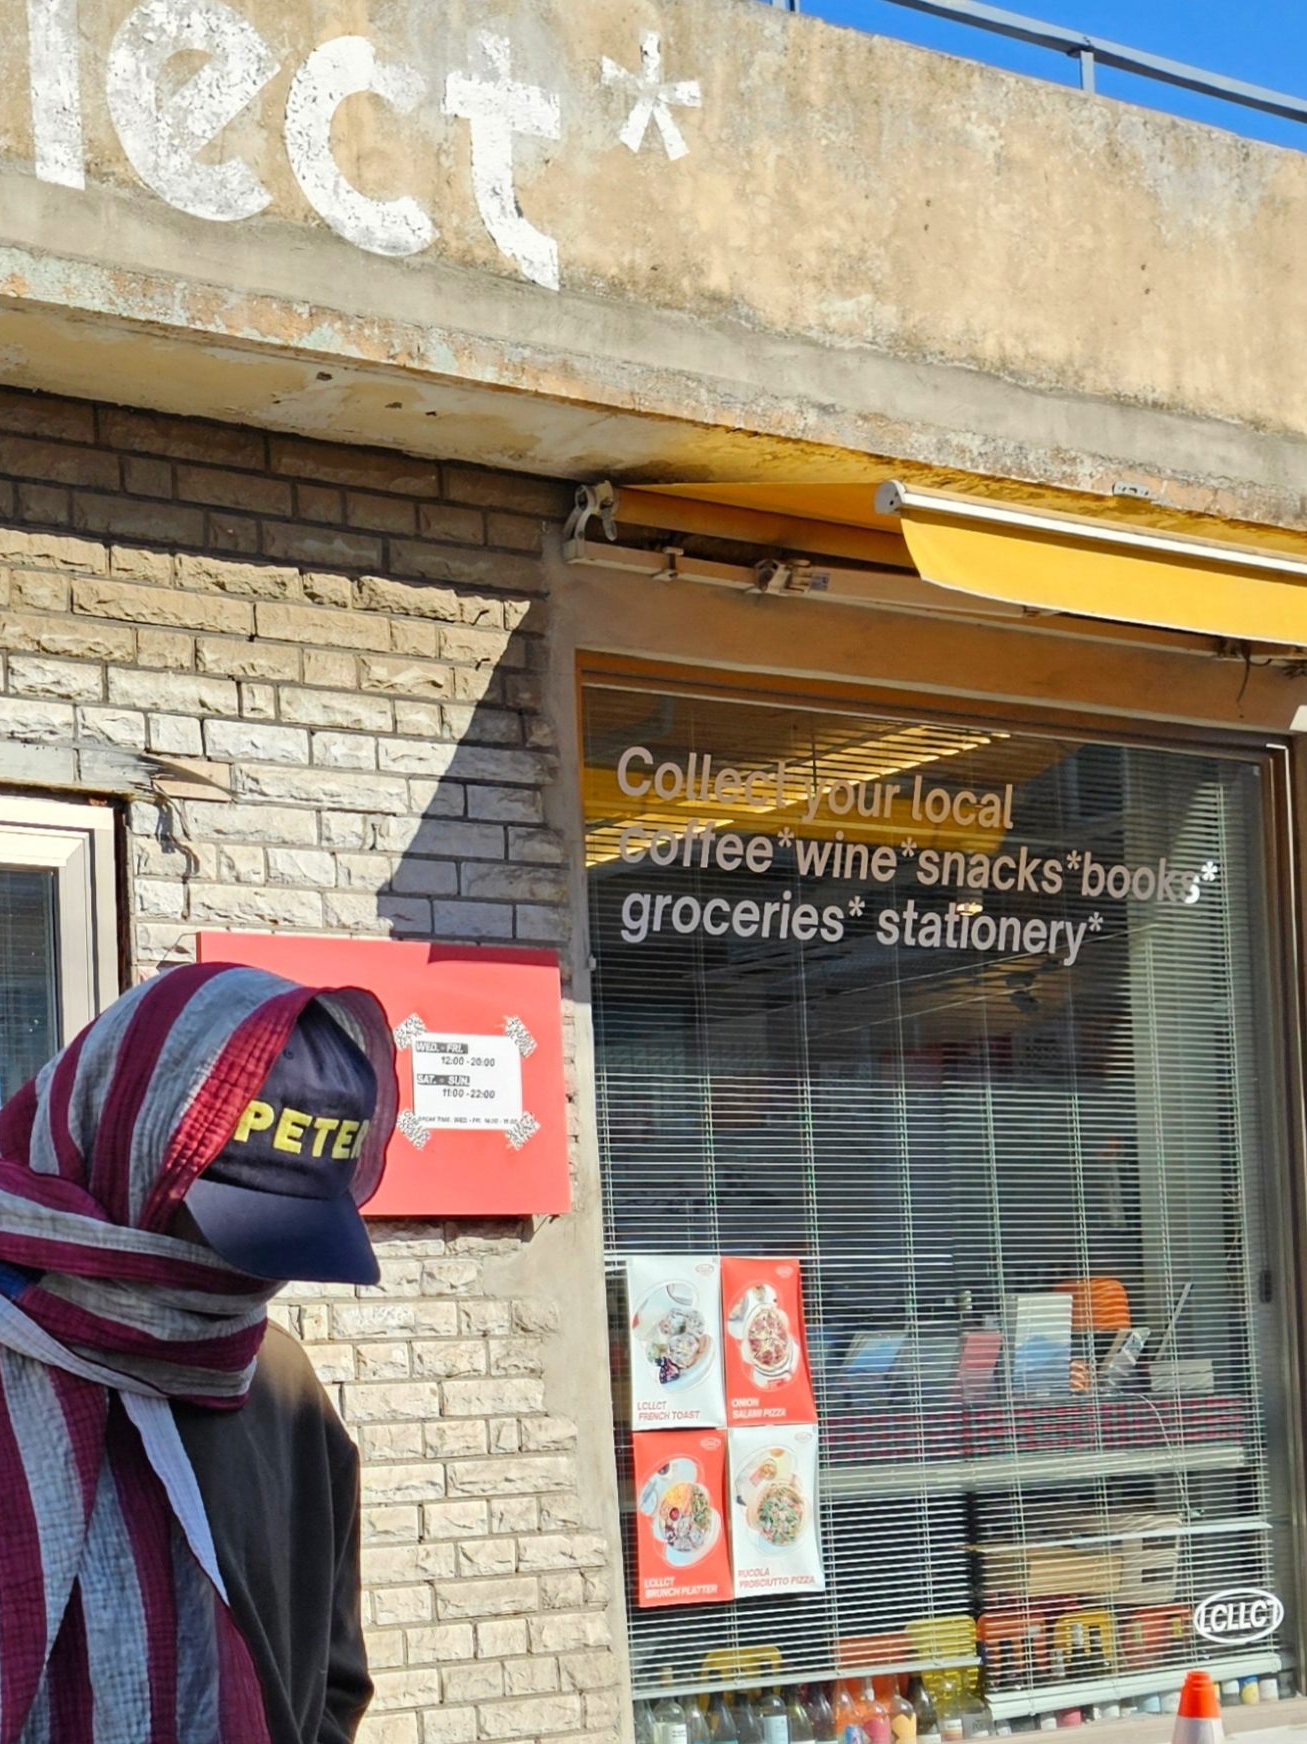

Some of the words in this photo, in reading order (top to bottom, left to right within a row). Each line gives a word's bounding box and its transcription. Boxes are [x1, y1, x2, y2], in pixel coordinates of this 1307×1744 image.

[617, 746, 787, 809] Collect
[801, 777, 901, 823] your
[911, 774, 1014, 829] local
[417, 1074, 437, 1085] SAT.
[638, 1411, 670, 1421] FRENCH
[672, 1410, 701, 1420] TOAST
[763, 1407, 787, 1418] PIZZA
[738, 1568, 770, 1578] RUCOLA
[739, 1576, 790, 1588] PROSCIUTTO
[790, 1575, 815, 1585] PIZZA
[645, 1587, 680, 1599] BRUNCH
[681, 1584, 718, 1596] PLATTER
